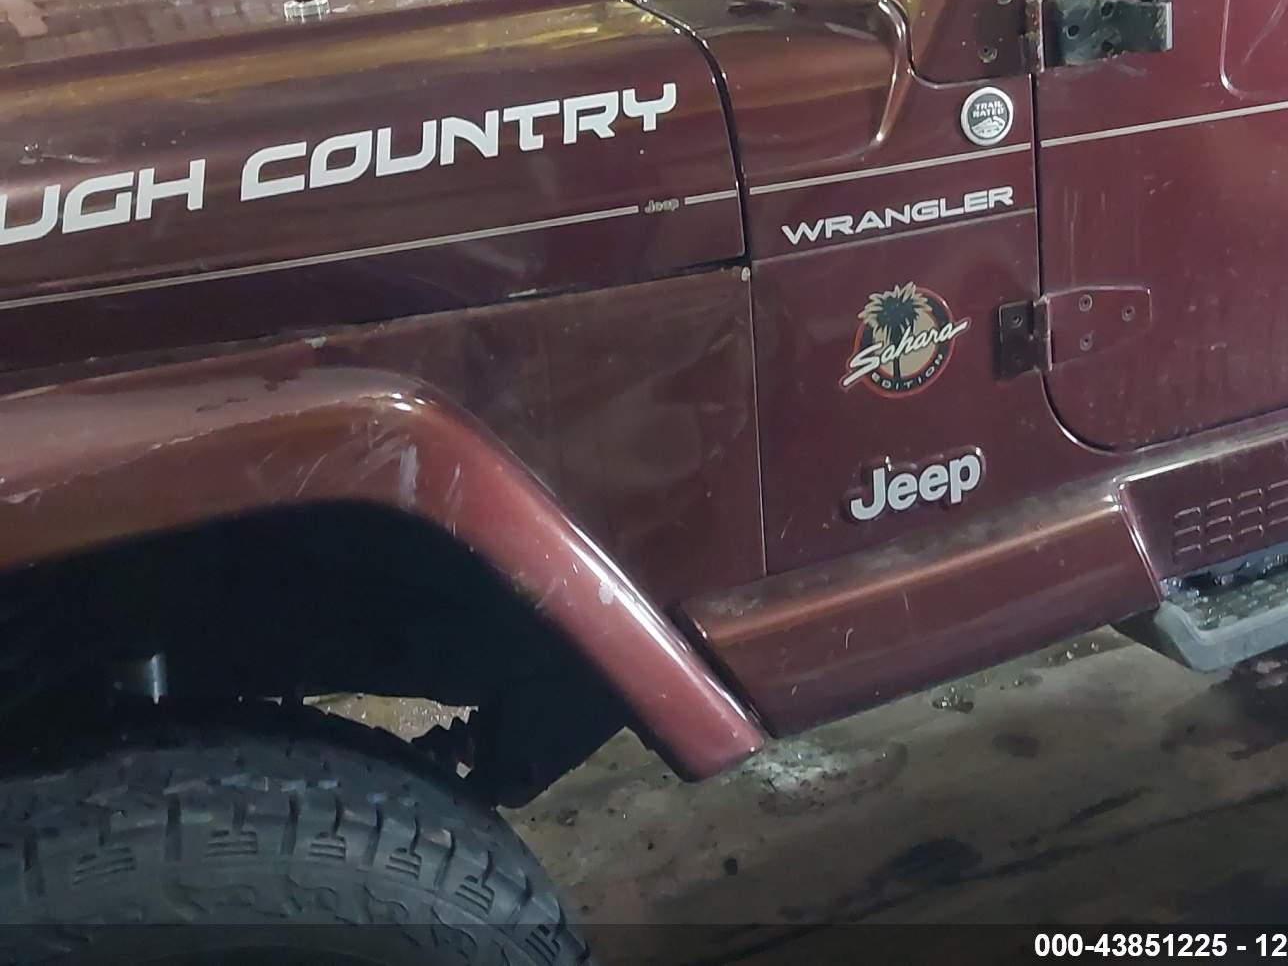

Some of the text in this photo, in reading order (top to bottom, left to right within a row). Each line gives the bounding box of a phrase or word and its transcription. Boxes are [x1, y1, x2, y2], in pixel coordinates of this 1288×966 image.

[972, 107, 1005, 118] RATED
[974, 100, 1003, 111] TRAIL
[241, 83, 678, 202] COUNTRY
[782, 186, 1014, 245] WRANGLER
[843, 321, 969, 386] Sahara
[871, 353, 944, 390] EDITION
[851, 453, 981, 521] Jeep
